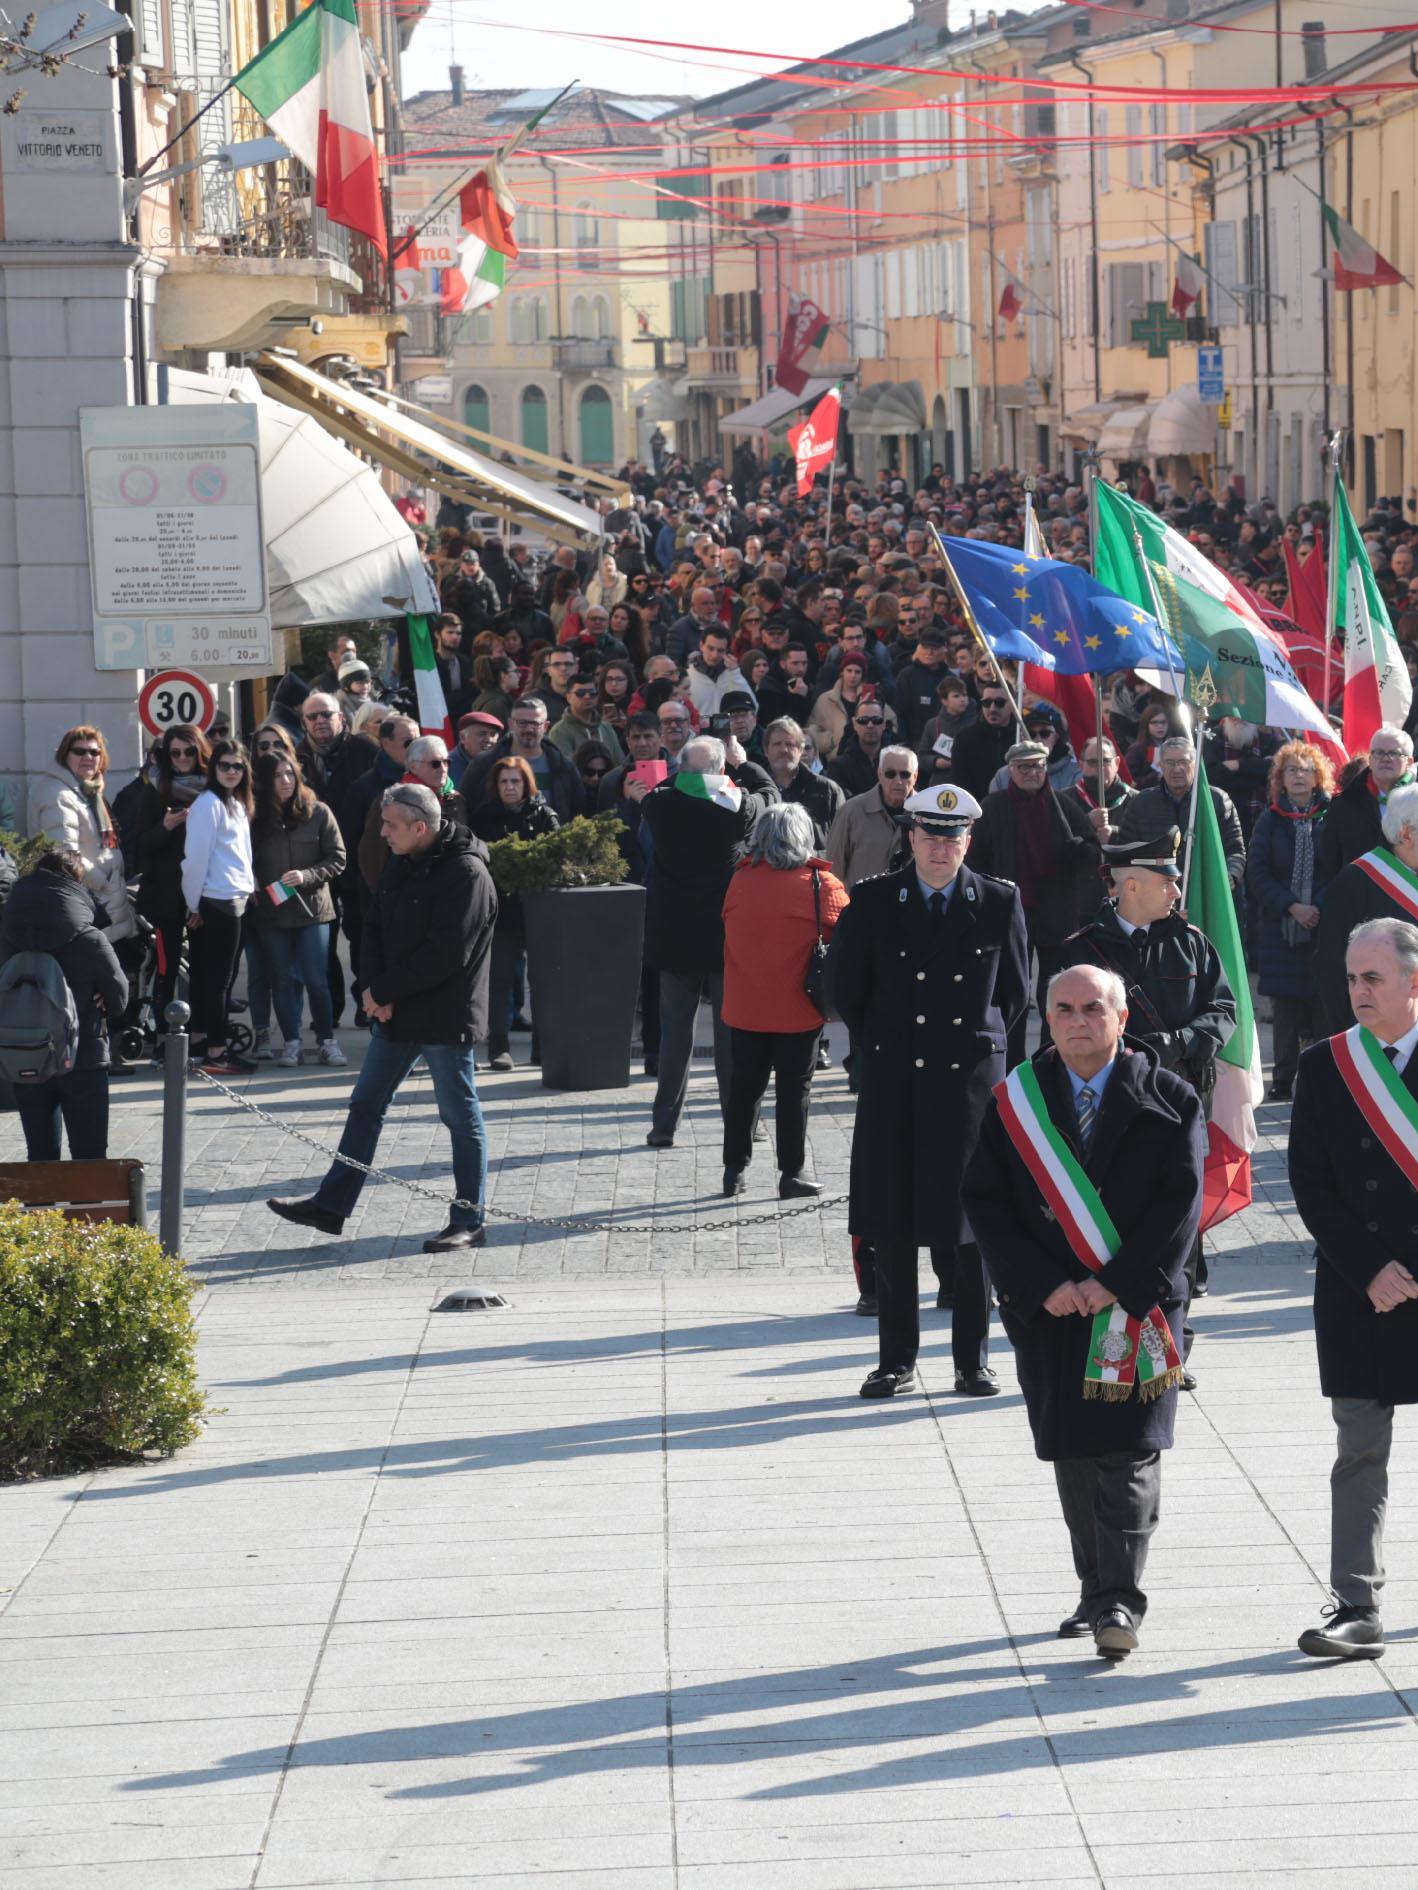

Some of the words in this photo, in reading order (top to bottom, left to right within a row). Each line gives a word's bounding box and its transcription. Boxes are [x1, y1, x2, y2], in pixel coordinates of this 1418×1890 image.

[41, 126, 76, 136] PIAZZA
[17, 143, 62, 157] VITTORIO
[64, 143, 104, 157] VENETO
[117, 451, 140, 462] ZONA
[142, 450, 185, 462] TRAFFICO
[186, 450, 227, 461] LIMITATO
[191, 626, 209, 641] 30
[217, 626, 258, 641] minuti
[103, 624, 135, 665] P
[1217, 647, 1284, 680] Sezione
[156, 691, 197, 723] 30
